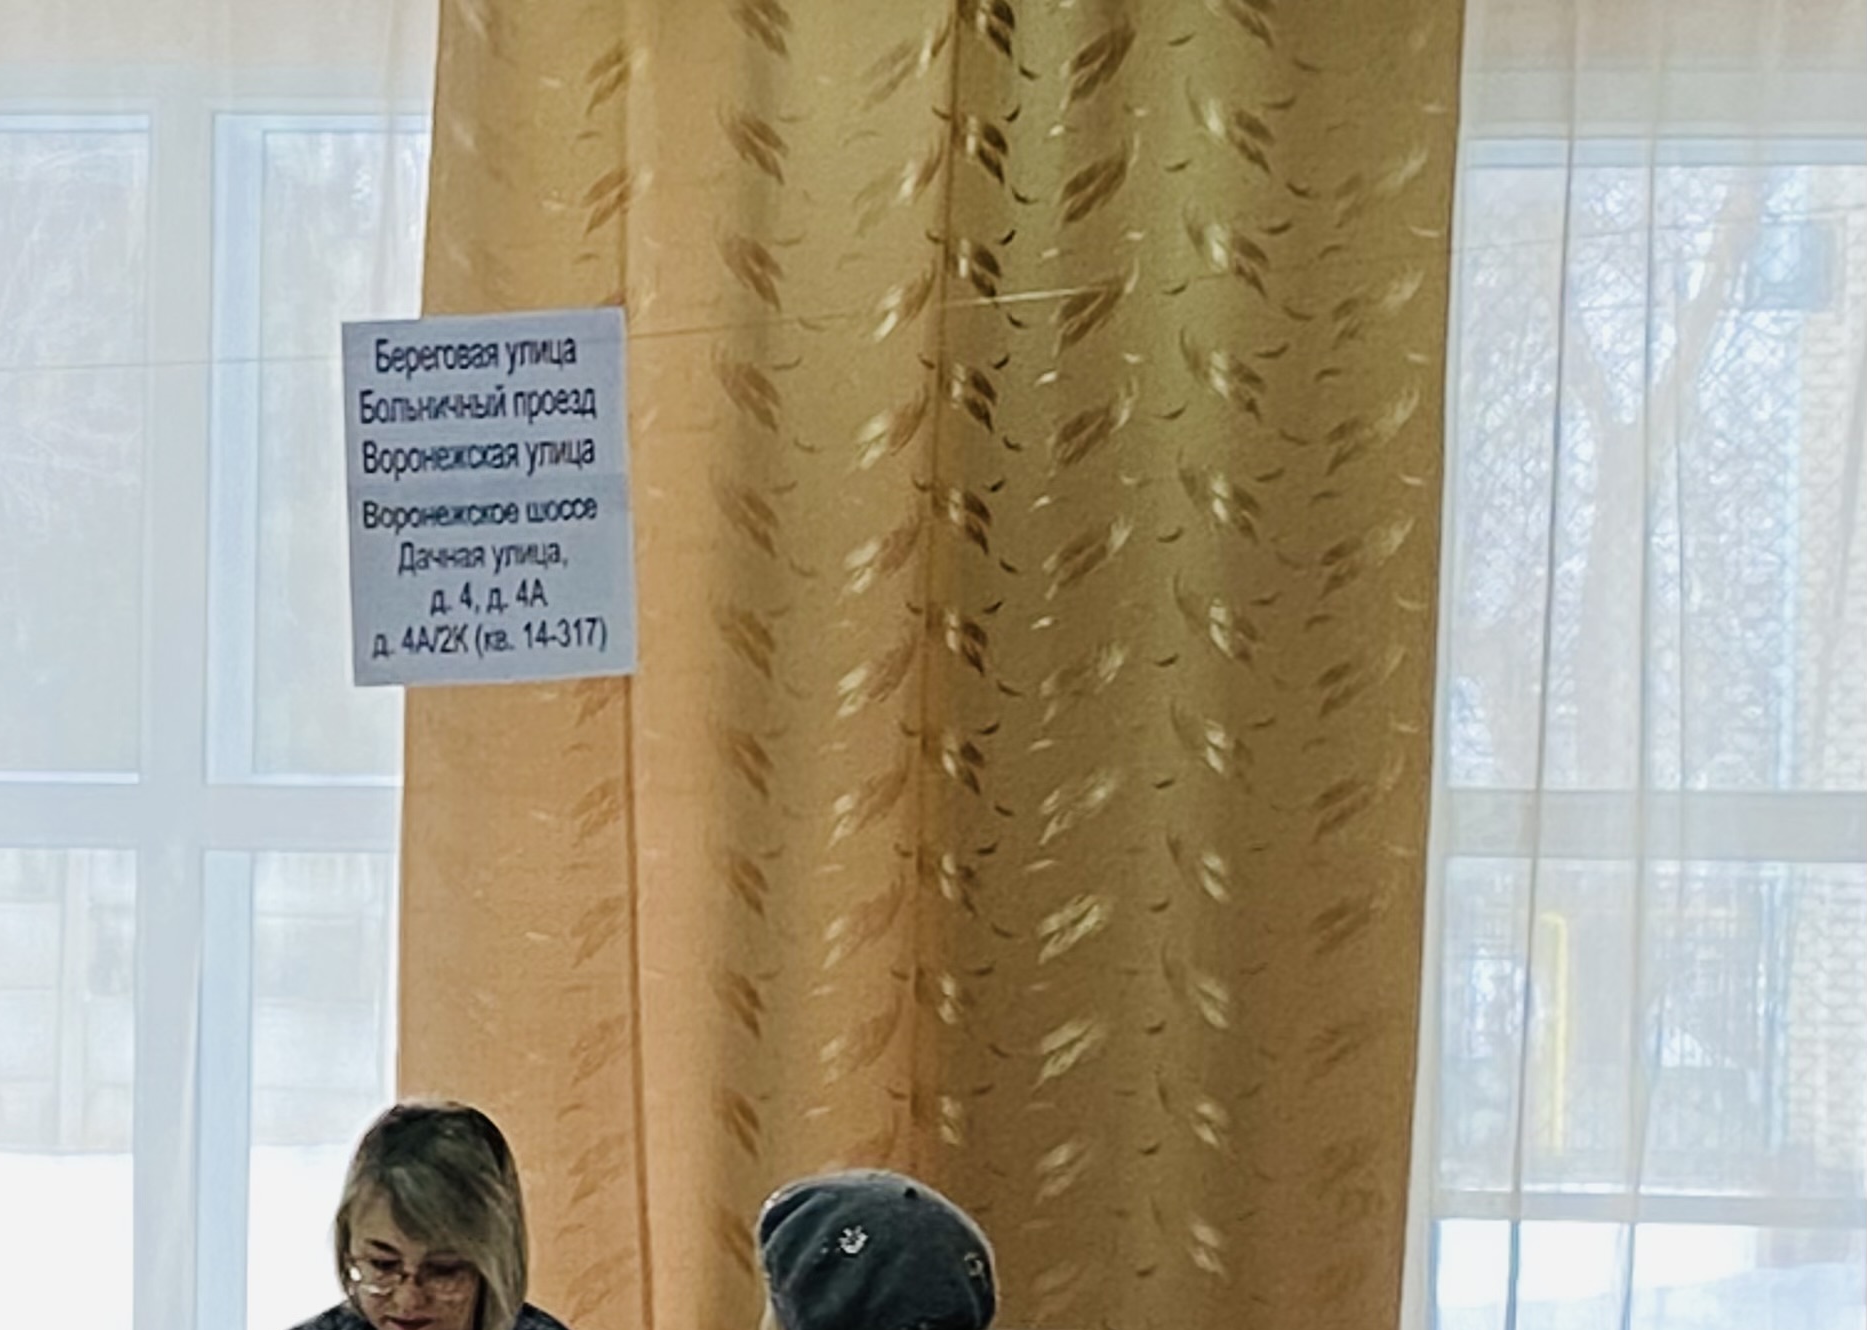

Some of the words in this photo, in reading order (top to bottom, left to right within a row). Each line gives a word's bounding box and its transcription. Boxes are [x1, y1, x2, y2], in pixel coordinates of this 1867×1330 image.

[375, 337, 499, 380] Береговая
[506, 336, 577, 375] улица
[359, 384, 507, 424] Больничный
[513, 387, 597, 425] проезд
[362, 439, 519, 482] Воронежская
[525, 437, 596, 477] улица
[363, 500, 519, 537] Воронежское
[526, 497, 598, 523] шоссе
[397, 541, 485, 576] Дачная
[491, 540, 569, 575] улица,
[430, 588, 453, 616] д.
[459, 581, 480, 614] 4,
[486, 586, 508, 614] д.
[516, 579, 548, 606] 4А
[372, 633, 395, 659] д.
[401, 623, 470, 655] 4А/2К
[474, 623, 515, 659] (кв.
[523, 617, 608, 654] 14-317)
